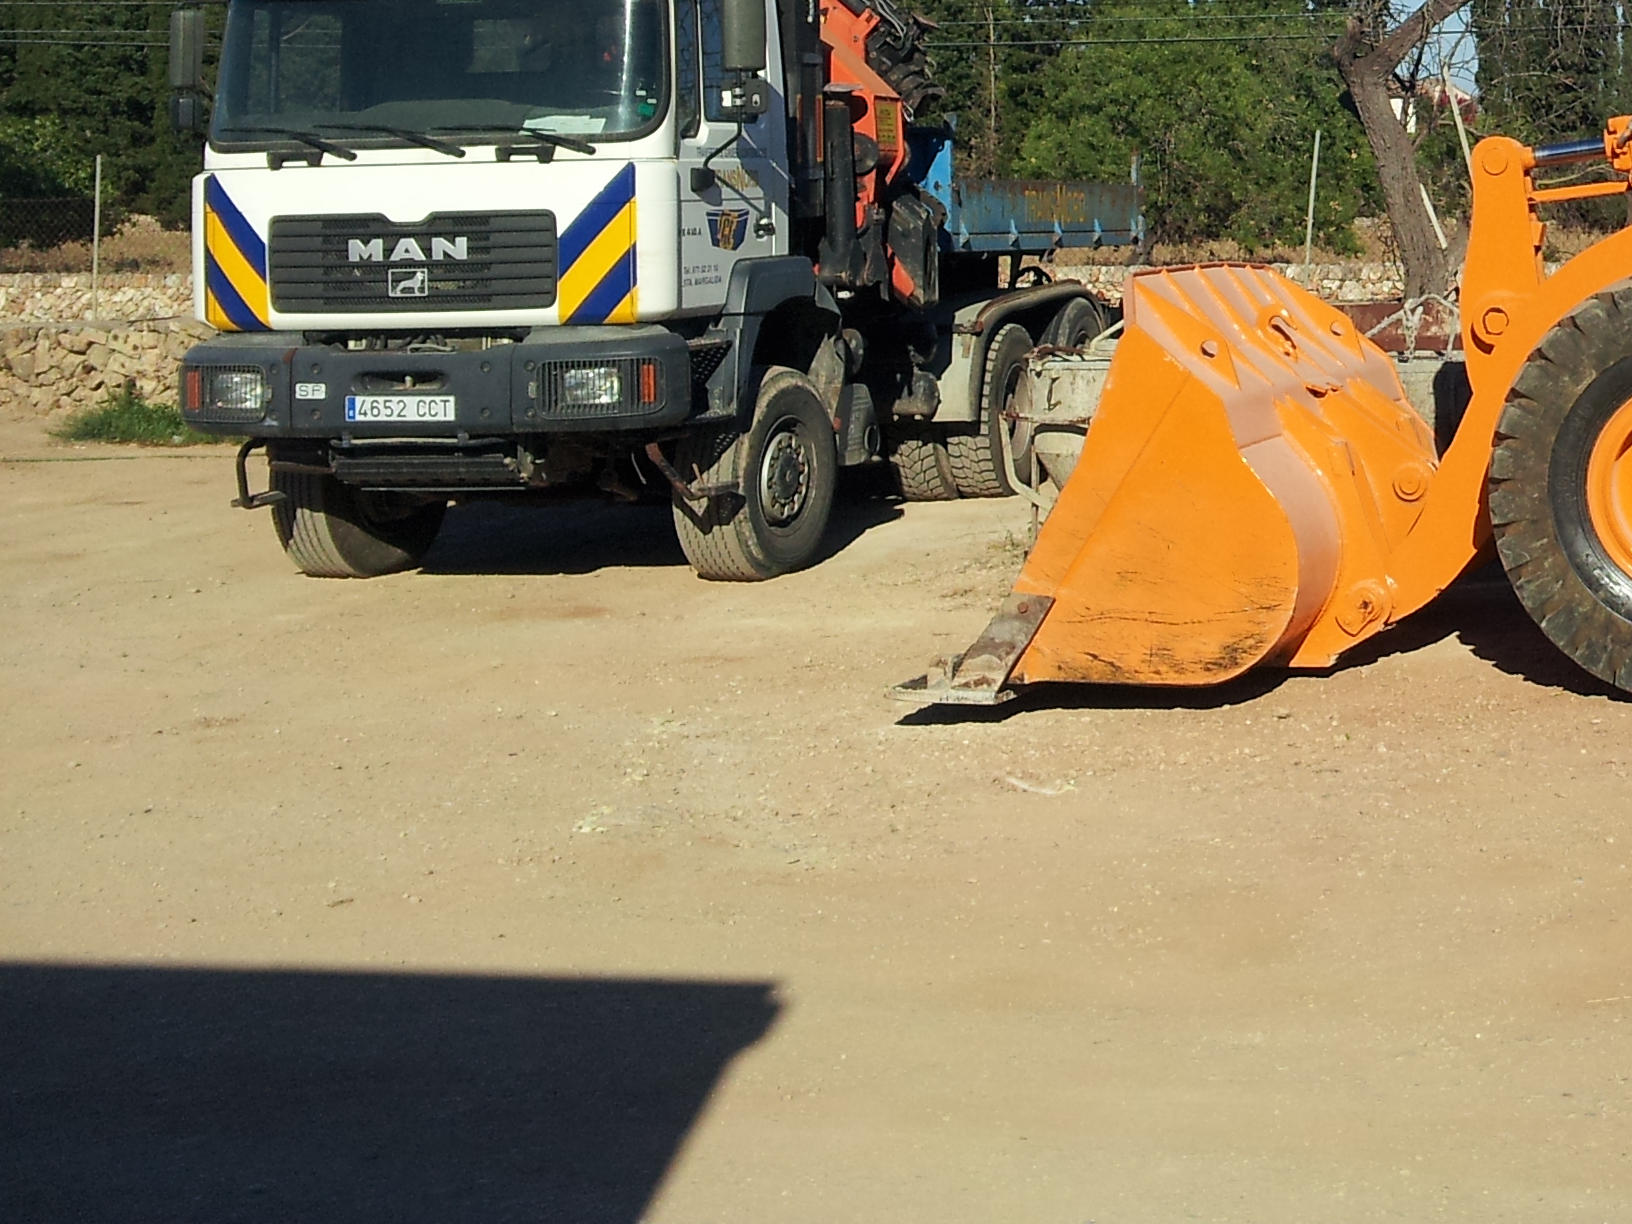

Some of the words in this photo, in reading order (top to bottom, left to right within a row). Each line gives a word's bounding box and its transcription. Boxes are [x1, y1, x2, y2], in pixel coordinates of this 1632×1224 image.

[348, 237, 468, 262] MAN
[298, 385, 323, 397] SP
[358, 399, 407, 418] 4652
[416, 399, 450, 418] CCT
